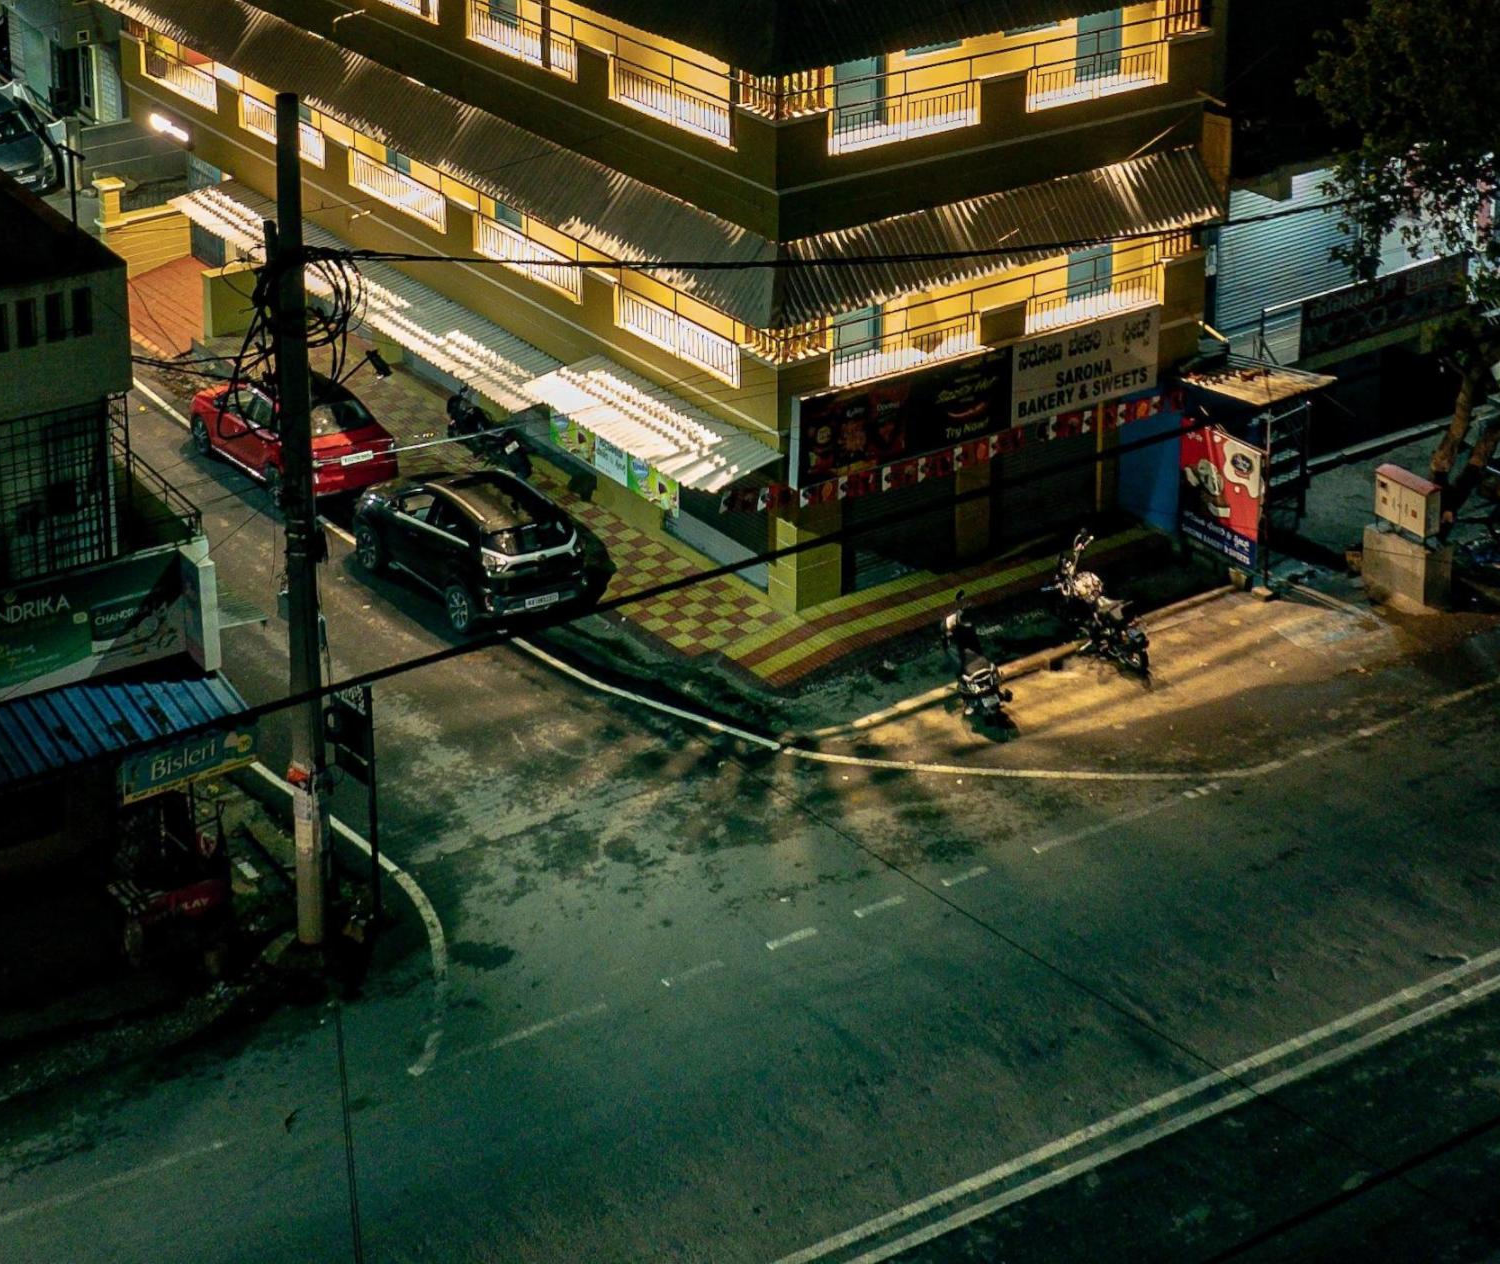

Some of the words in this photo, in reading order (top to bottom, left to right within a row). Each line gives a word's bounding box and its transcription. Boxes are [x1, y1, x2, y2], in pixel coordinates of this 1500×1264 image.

[1017, 387, 1075, 419] BAKERY
[1077, 382, 1089, 401] &
[1092, 366, 1149, 397] SWEETS
[1055, 358, 1113, 388] SARONA
[149, 739, 216, 782] Bisleri
